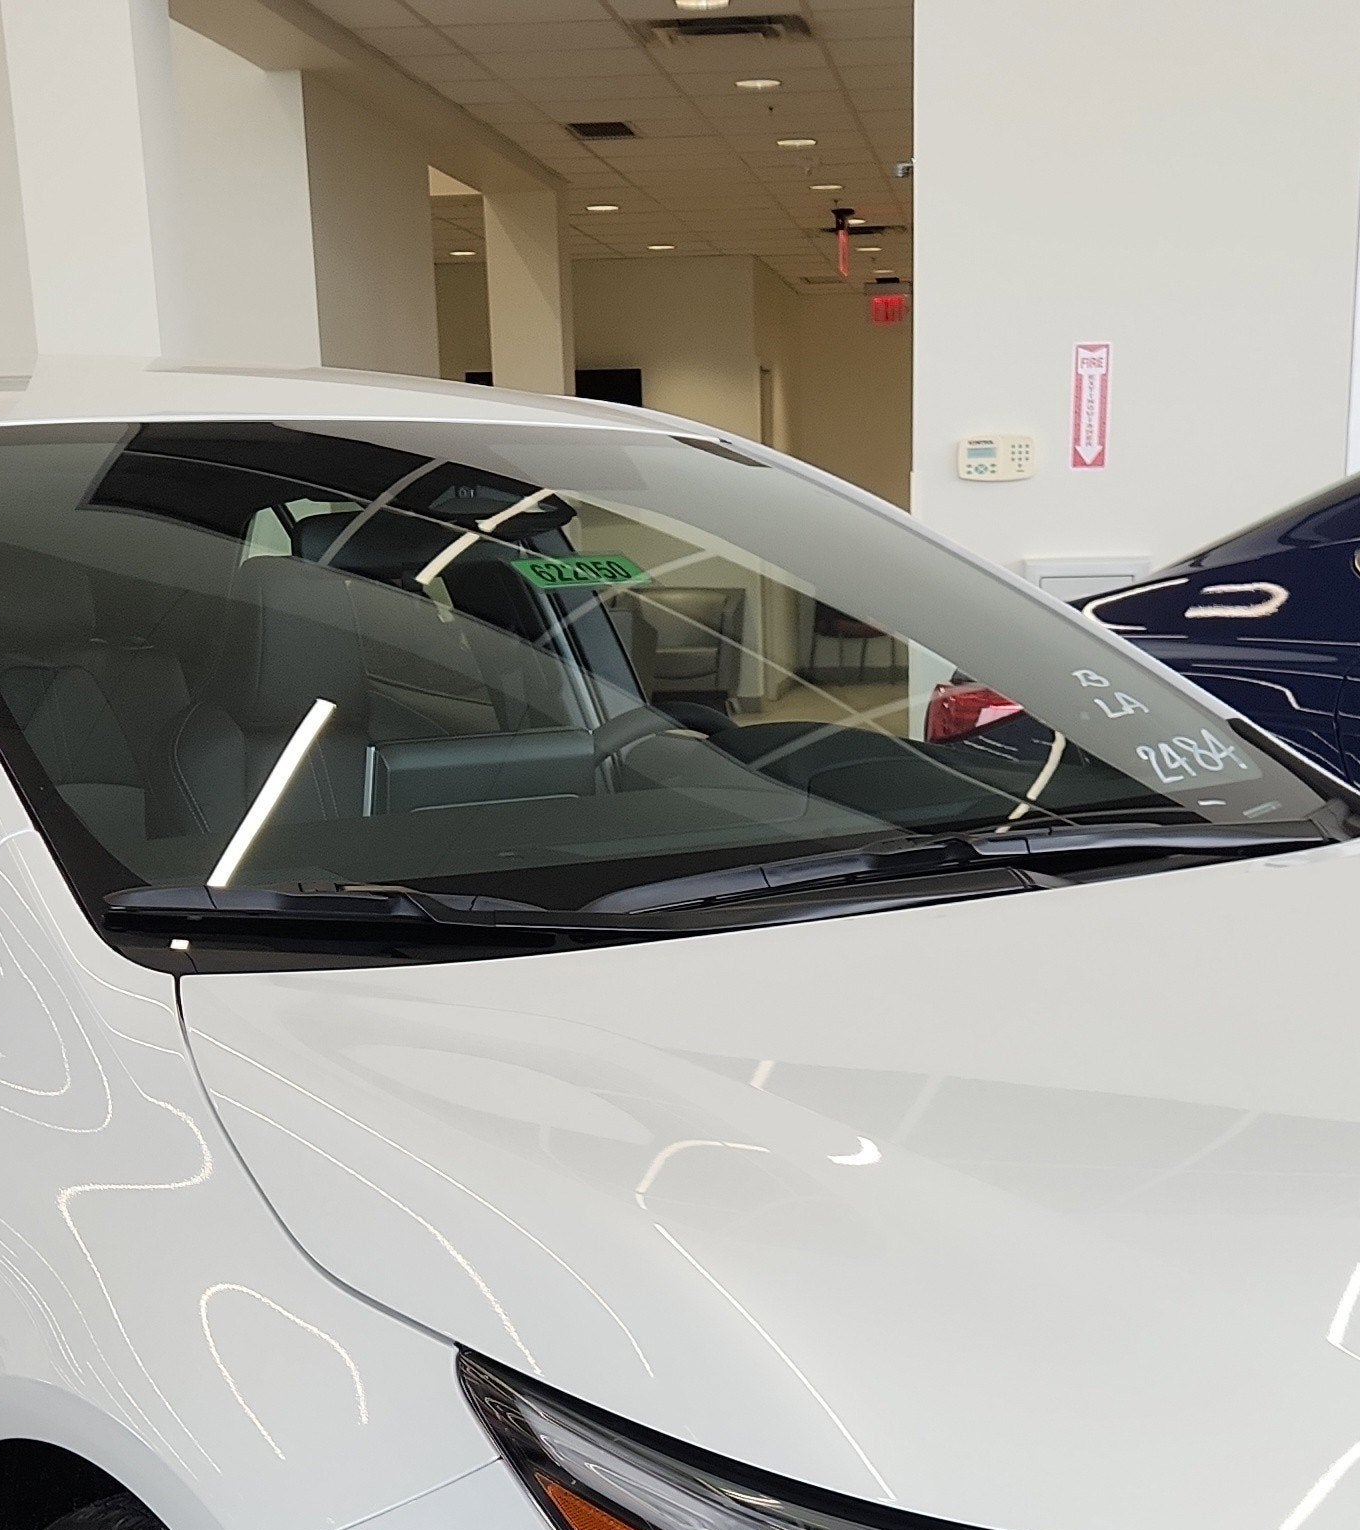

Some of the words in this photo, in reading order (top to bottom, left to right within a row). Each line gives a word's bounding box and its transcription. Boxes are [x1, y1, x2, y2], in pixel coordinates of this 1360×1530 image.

[1080, 357, 1104, 369] FIRE
[530, 560, 632, 583] 622050
[1093, 691, 1150, 719] LA
[1135, 728, 1248, 784] 2484
